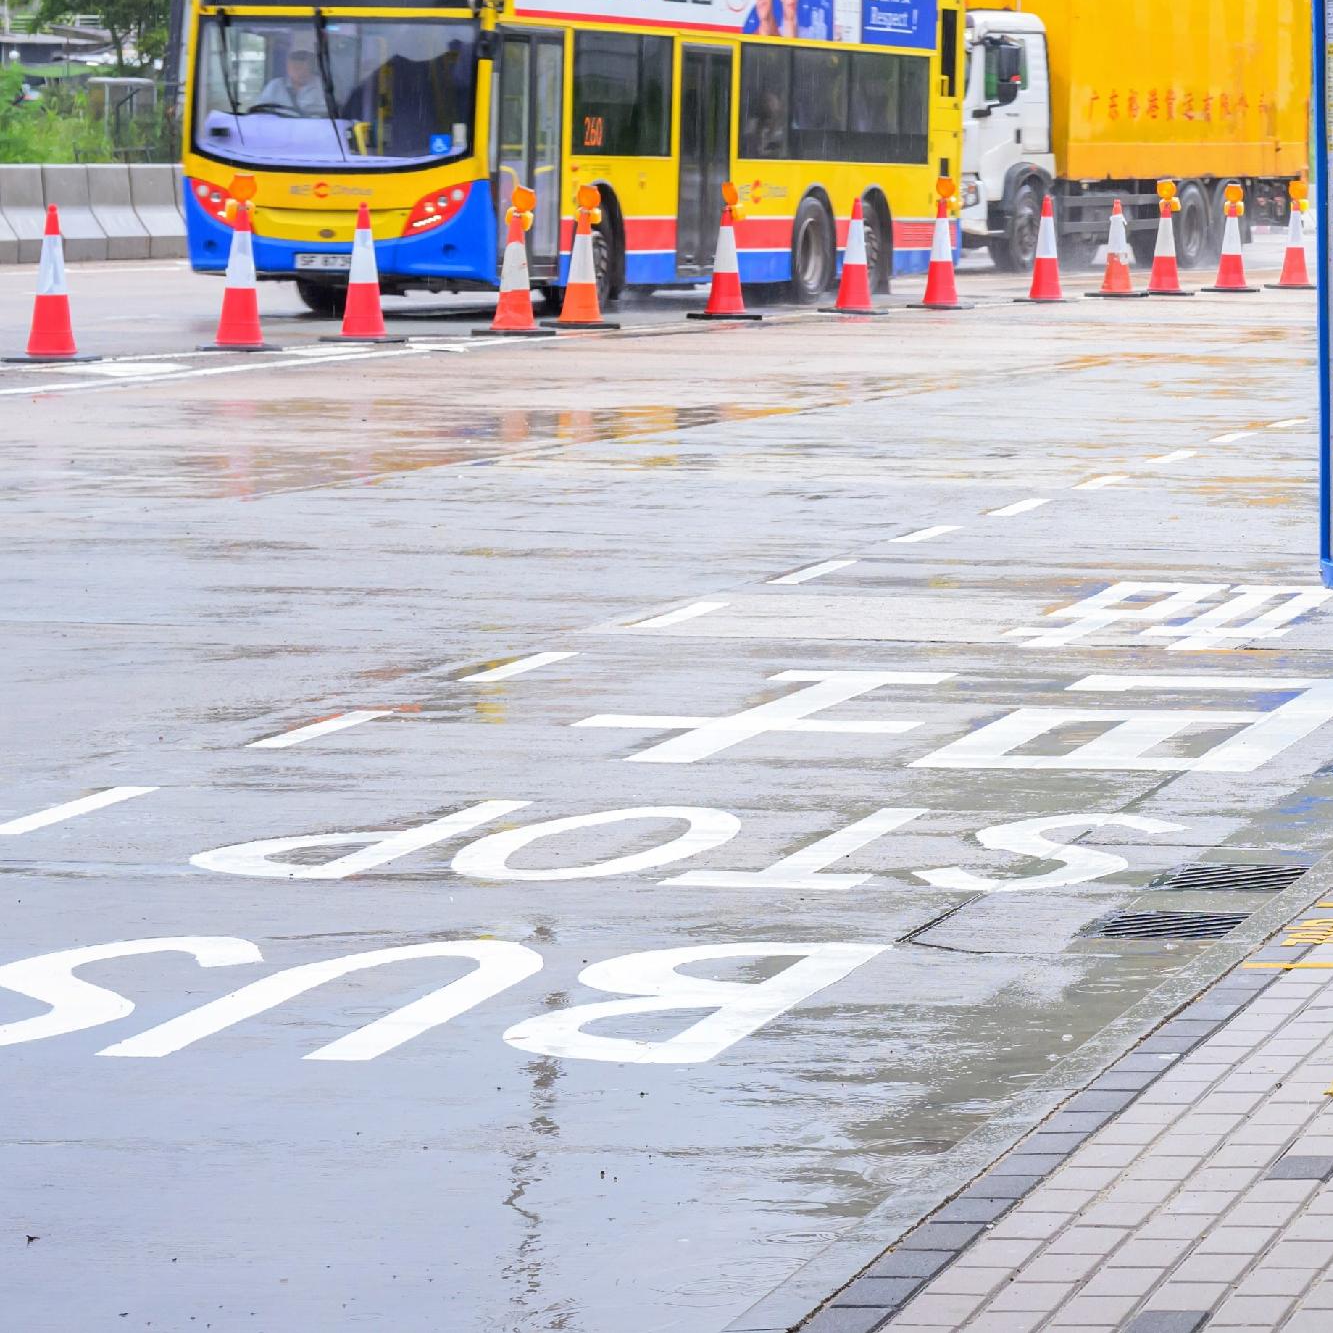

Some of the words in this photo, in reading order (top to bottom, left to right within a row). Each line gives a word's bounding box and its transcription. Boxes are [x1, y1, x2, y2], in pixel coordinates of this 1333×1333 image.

[583, 116, 604, 146] 260
[189, 800, 1188, 892] STOP
[0, 935, 893, 1066] BUS
